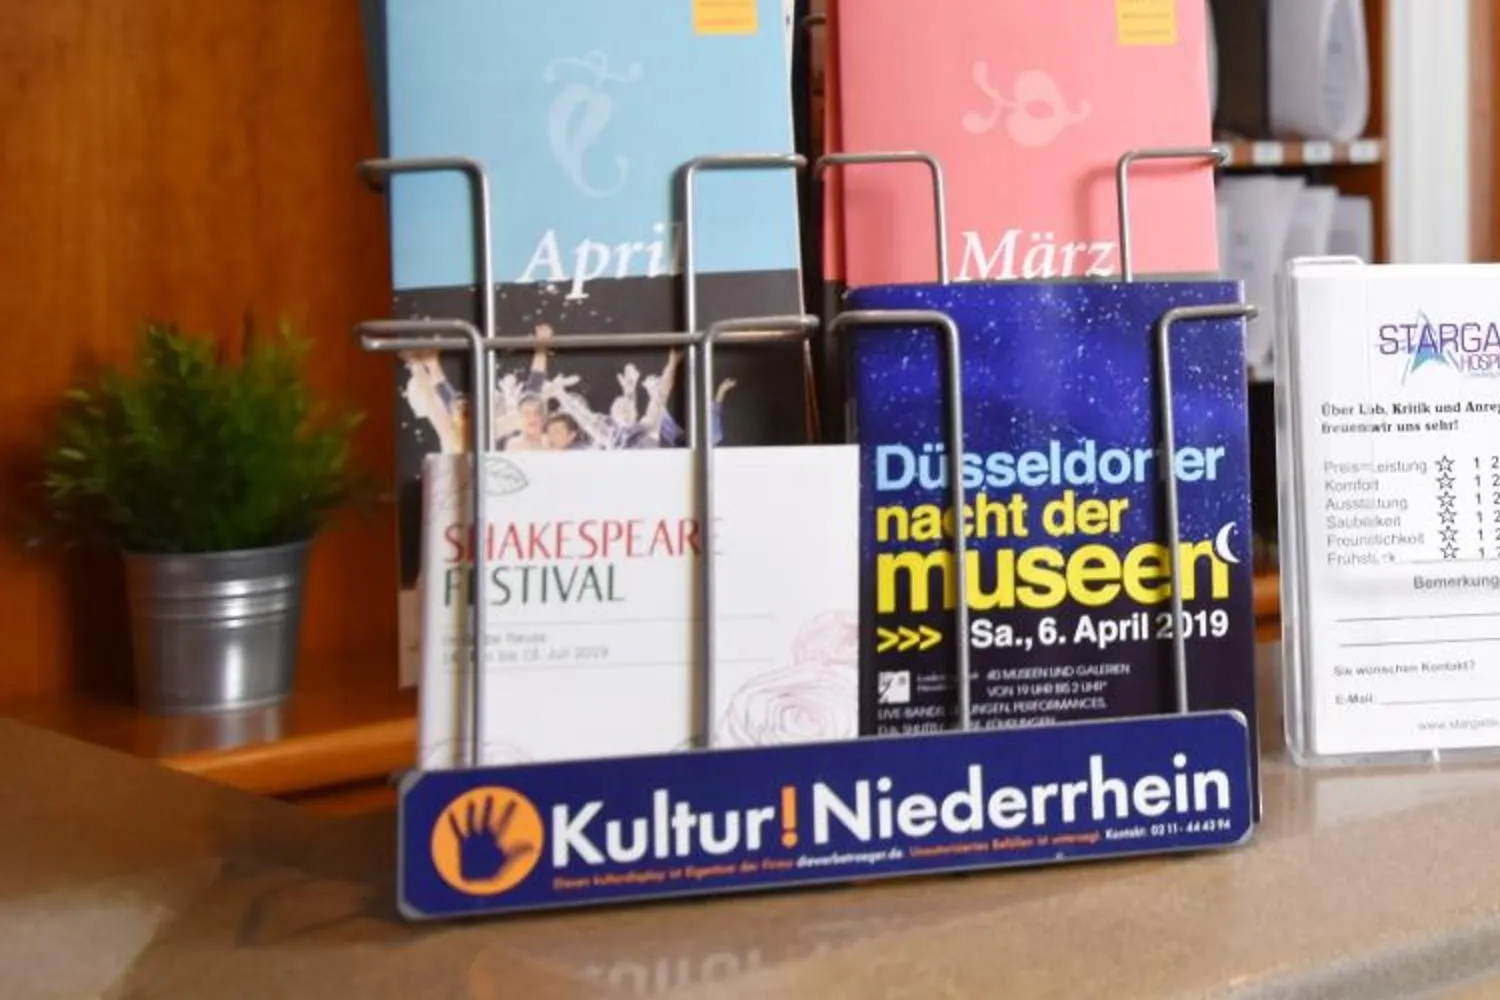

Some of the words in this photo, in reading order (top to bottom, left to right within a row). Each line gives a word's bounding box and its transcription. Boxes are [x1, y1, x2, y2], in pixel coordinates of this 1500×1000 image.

[954, 228, 1119, 282] März
[1320, 401, 1354, 417] Über
[1392, 401, 1432, 415] Kritik
[1435, 400, 1461, 414] und
[1396, 422, 1421, 432] uns
[1425, 418, 1459, 432] sehr!
[1491, 455, 1500, 469] 2
[1492, 474, 1500, 487] 2
[876, 492, 1030, 543] nacht
[1042, 489, 1129, 538] der
[876, 538, 1230, 614] museen
[971, 618, 1033, 651] Sa.,
[1037, 617, 1067, 646] 6.
[1073, 613, 1149, 649] April
[1155, 609, 1229, 643] 2019
[552, 785, 798, 869] Kultur!
[812, 753, 1231, 845] Niederrhein
